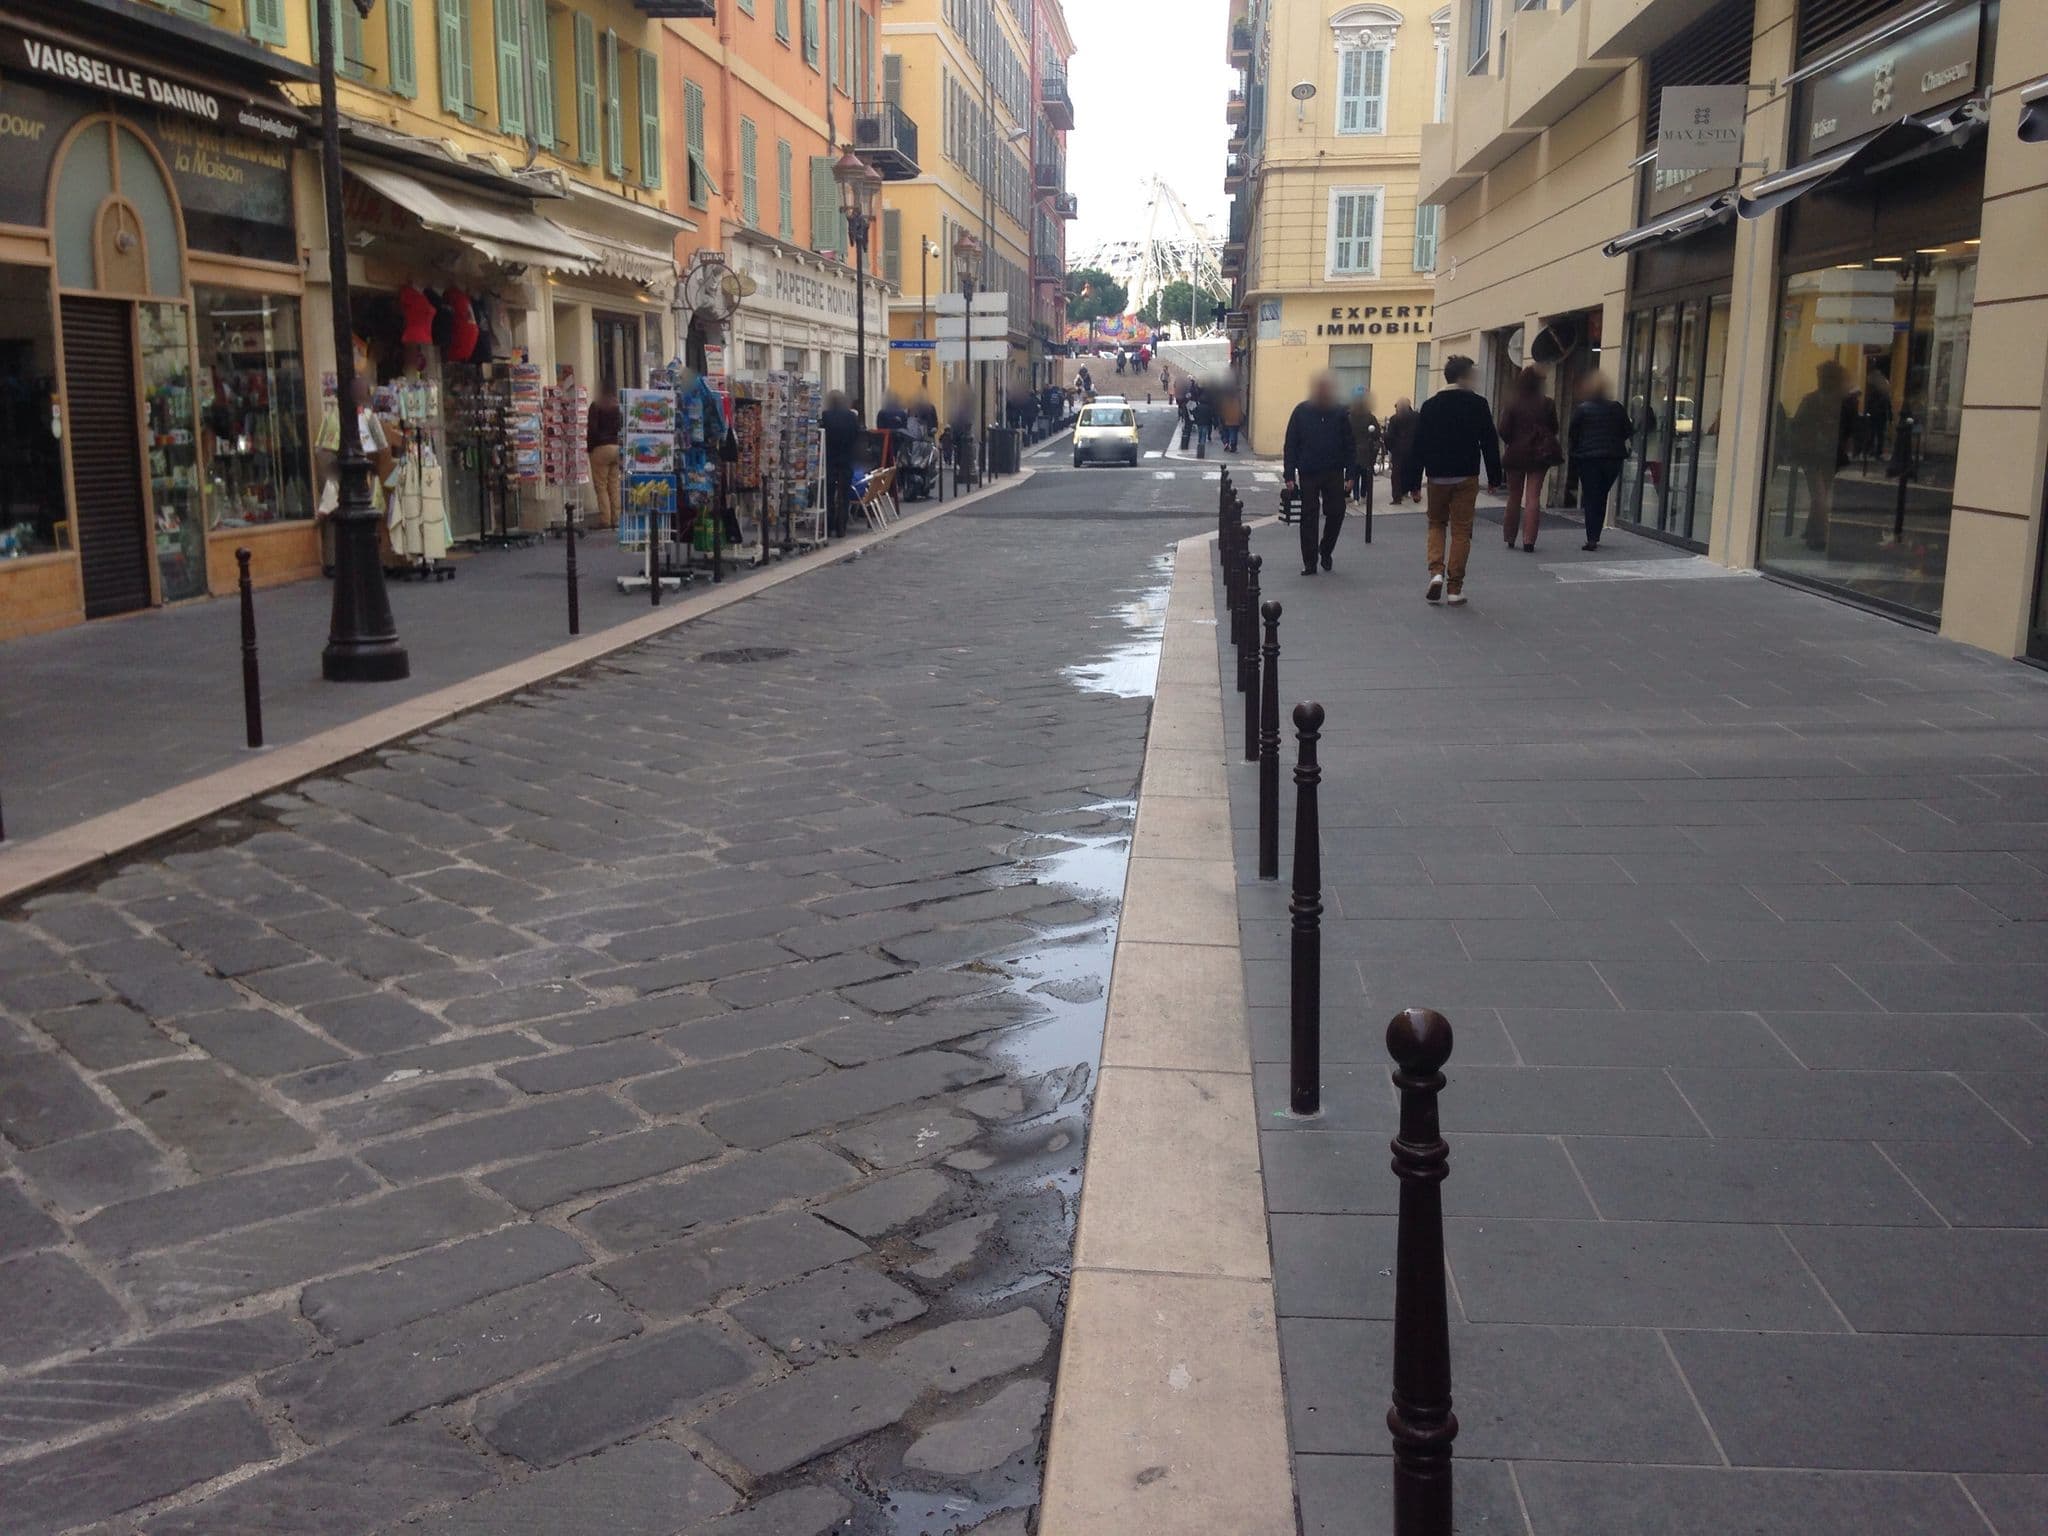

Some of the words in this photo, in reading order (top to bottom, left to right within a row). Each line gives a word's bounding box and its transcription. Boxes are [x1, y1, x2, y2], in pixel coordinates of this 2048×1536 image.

[23, 38, 145, 98] VAISSELLE
[147, 76, 219, 120] DANINO
[0, 112, 46, 141] pour
[1664, 128, 1694, 140] MAX
[175, 146, 190, 172] la
[192, 150, 244, 184] Maison
[776, 268, 824, 310] PAPETERIE
[827, 284, 858, 318] RONTAN
